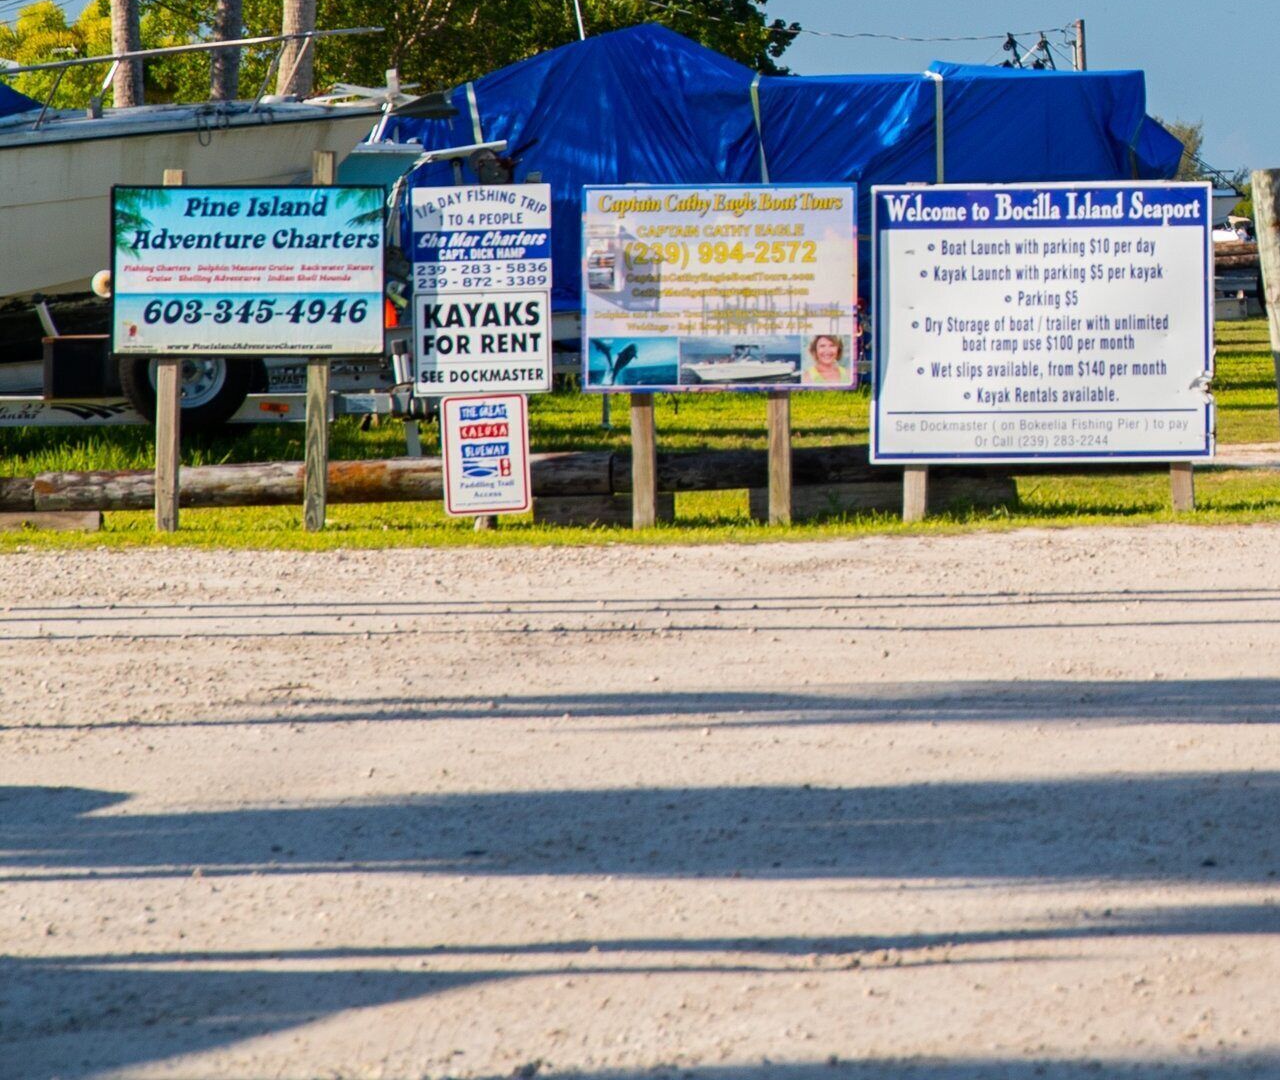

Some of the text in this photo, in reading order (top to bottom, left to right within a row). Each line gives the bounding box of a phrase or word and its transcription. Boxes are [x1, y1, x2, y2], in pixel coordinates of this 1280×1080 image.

[184, 196, 327, 218] Pine Island
[414, 189, 548, 219] 1/2 DAY FISHING TRIP
[598, 192, 842, 218] Captain Cathy Eagle Boat Tours
[884, 191, 1201, 226] Welcome to Bocilla Island Seaport
[439, 212, 523, 226] 1 TO 4 PEOPLE
[131, 228, 380, 250] Adventure Charters
[417, 231, 547, 248] She Mar Charters
[636, 224, 805, 237] CAPTAIN CATHY EAGLE
[438, 247, 526, 261] CAPT. DICK HAMP
[624, 241, 817, 269] (239) 994-2572
[941, 239, 1156, 257] Boat Launch with parking $10 per day
[933, 263, 1163, 283] Kayak Launch with parking $5 per kayak
[1018, 290, 1078, 309] Parking $5
[144, 299, 368, 324] 603-345-4946
[424, 301, 540, 329] KAYAKS
[925, 317, 942, 335] Dry
[947, 316, 990, 333] Storage
[995, 316, 1007, 331] of
[1009, 315, 1035, 331] boat
[1046, 315, 1081, 331] trailer
[1086, 315, 1110, 331] with
[1114, 314, 1169, 330] unlimited
[423, 333, 541, 356] FOR RENT
[962, 334, 1135, 353] boat ramp use $100 per month
[421, 368, 544, 384] SEE DOCKMASTER
[931, 360, 1167, 379] Wet slips available, from $140 per month
[976, 386, 1119, 406] Kayak Rentals available.
[462, 406, 506, 418] THE GREAT
[461, 425, 507, 438] CALUSA
[895, 419, 917, 432] See
[920, 419, 988, 432] Dockmaster
[1000, 421, 1016, 431] on
[1071, 418, 1113, 433] Fishing
[1118, 418, 1140, 430] Pier
[1153, 418, 1164, 430] to
[1169, 419, 1189, 432] pay
[974, 434, 1108, 448] Or Call (239) 283-2244
[465, 445, 506, 457] BLUEWAY
[460, 481, 495, 489] Paddling
